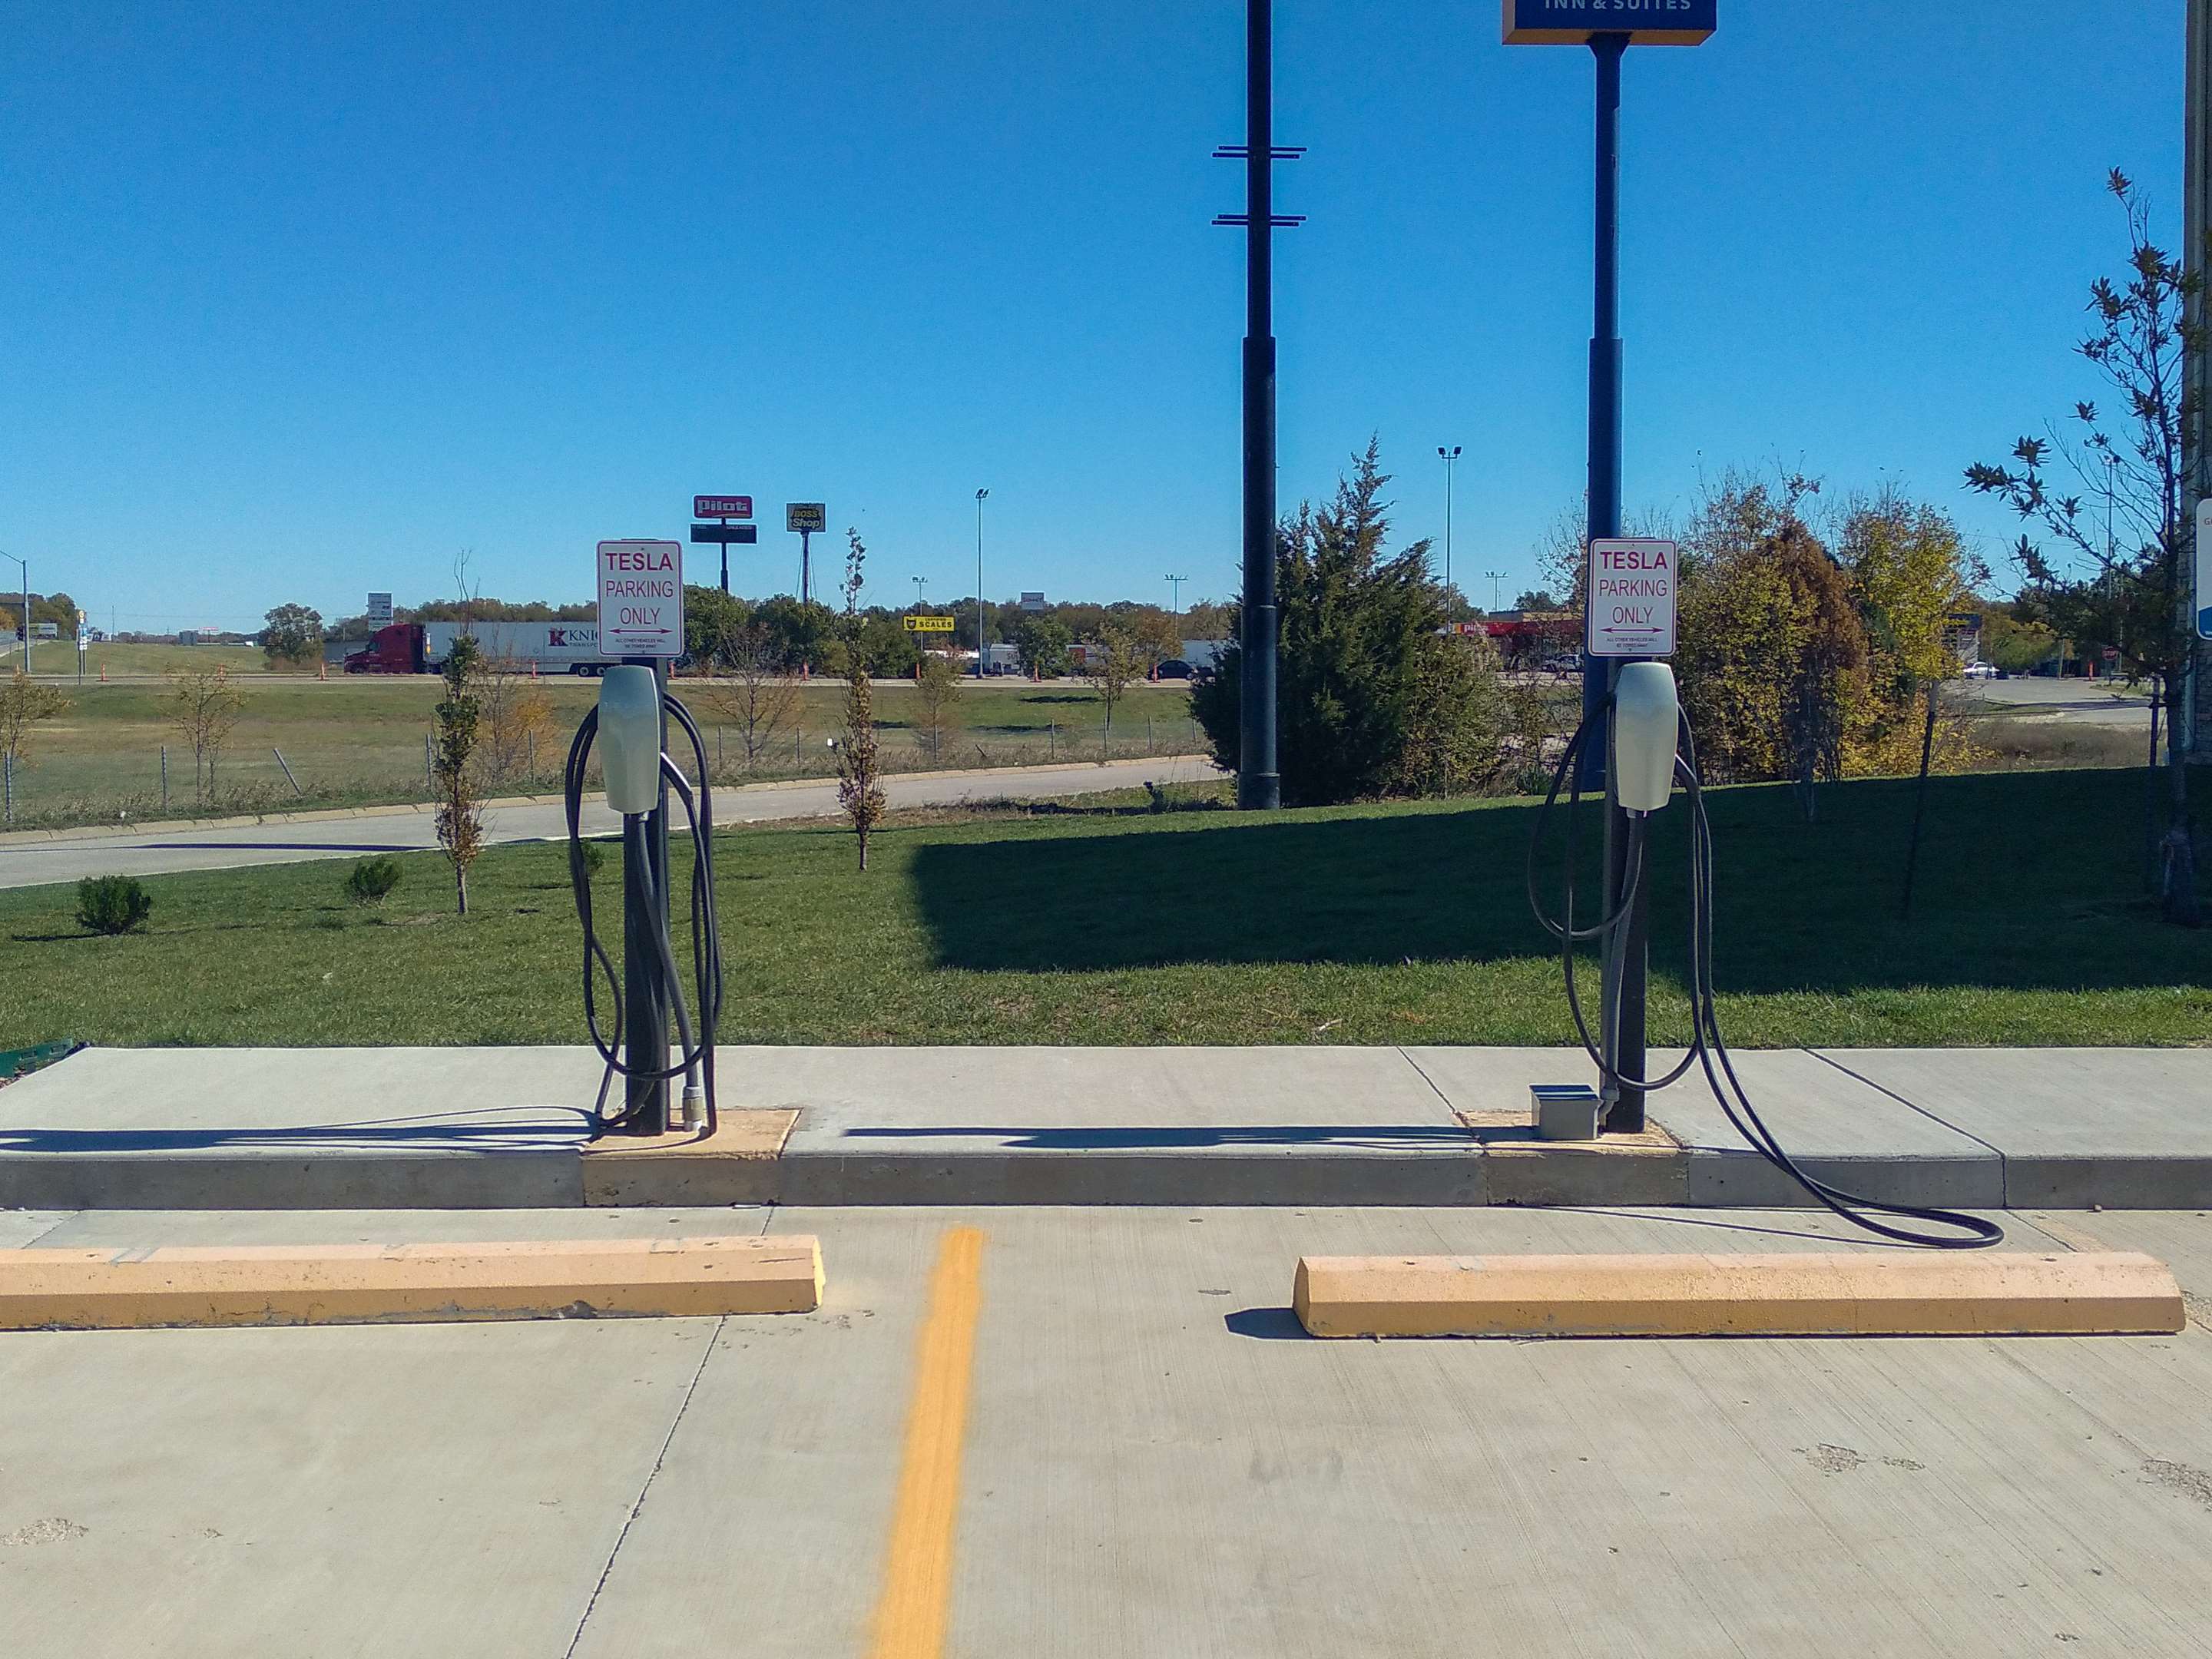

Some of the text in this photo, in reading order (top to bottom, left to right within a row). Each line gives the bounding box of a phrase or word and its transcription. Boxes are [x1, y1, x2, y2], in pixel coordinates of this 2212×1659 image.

[1545, 0, 1690, 9] INN & SUITES
[792, 518, 820, 528] Shop
[605, 552, 674, 571] TESLA
[1600, 551, 1667, 569] TESLA
[606, 580, 674, 598] PARKING
[1599, 579, 1667, 597] PARKING
[620, 608, 661, 624] ONLY
[1612, 606, 1653, 624] ONLY
